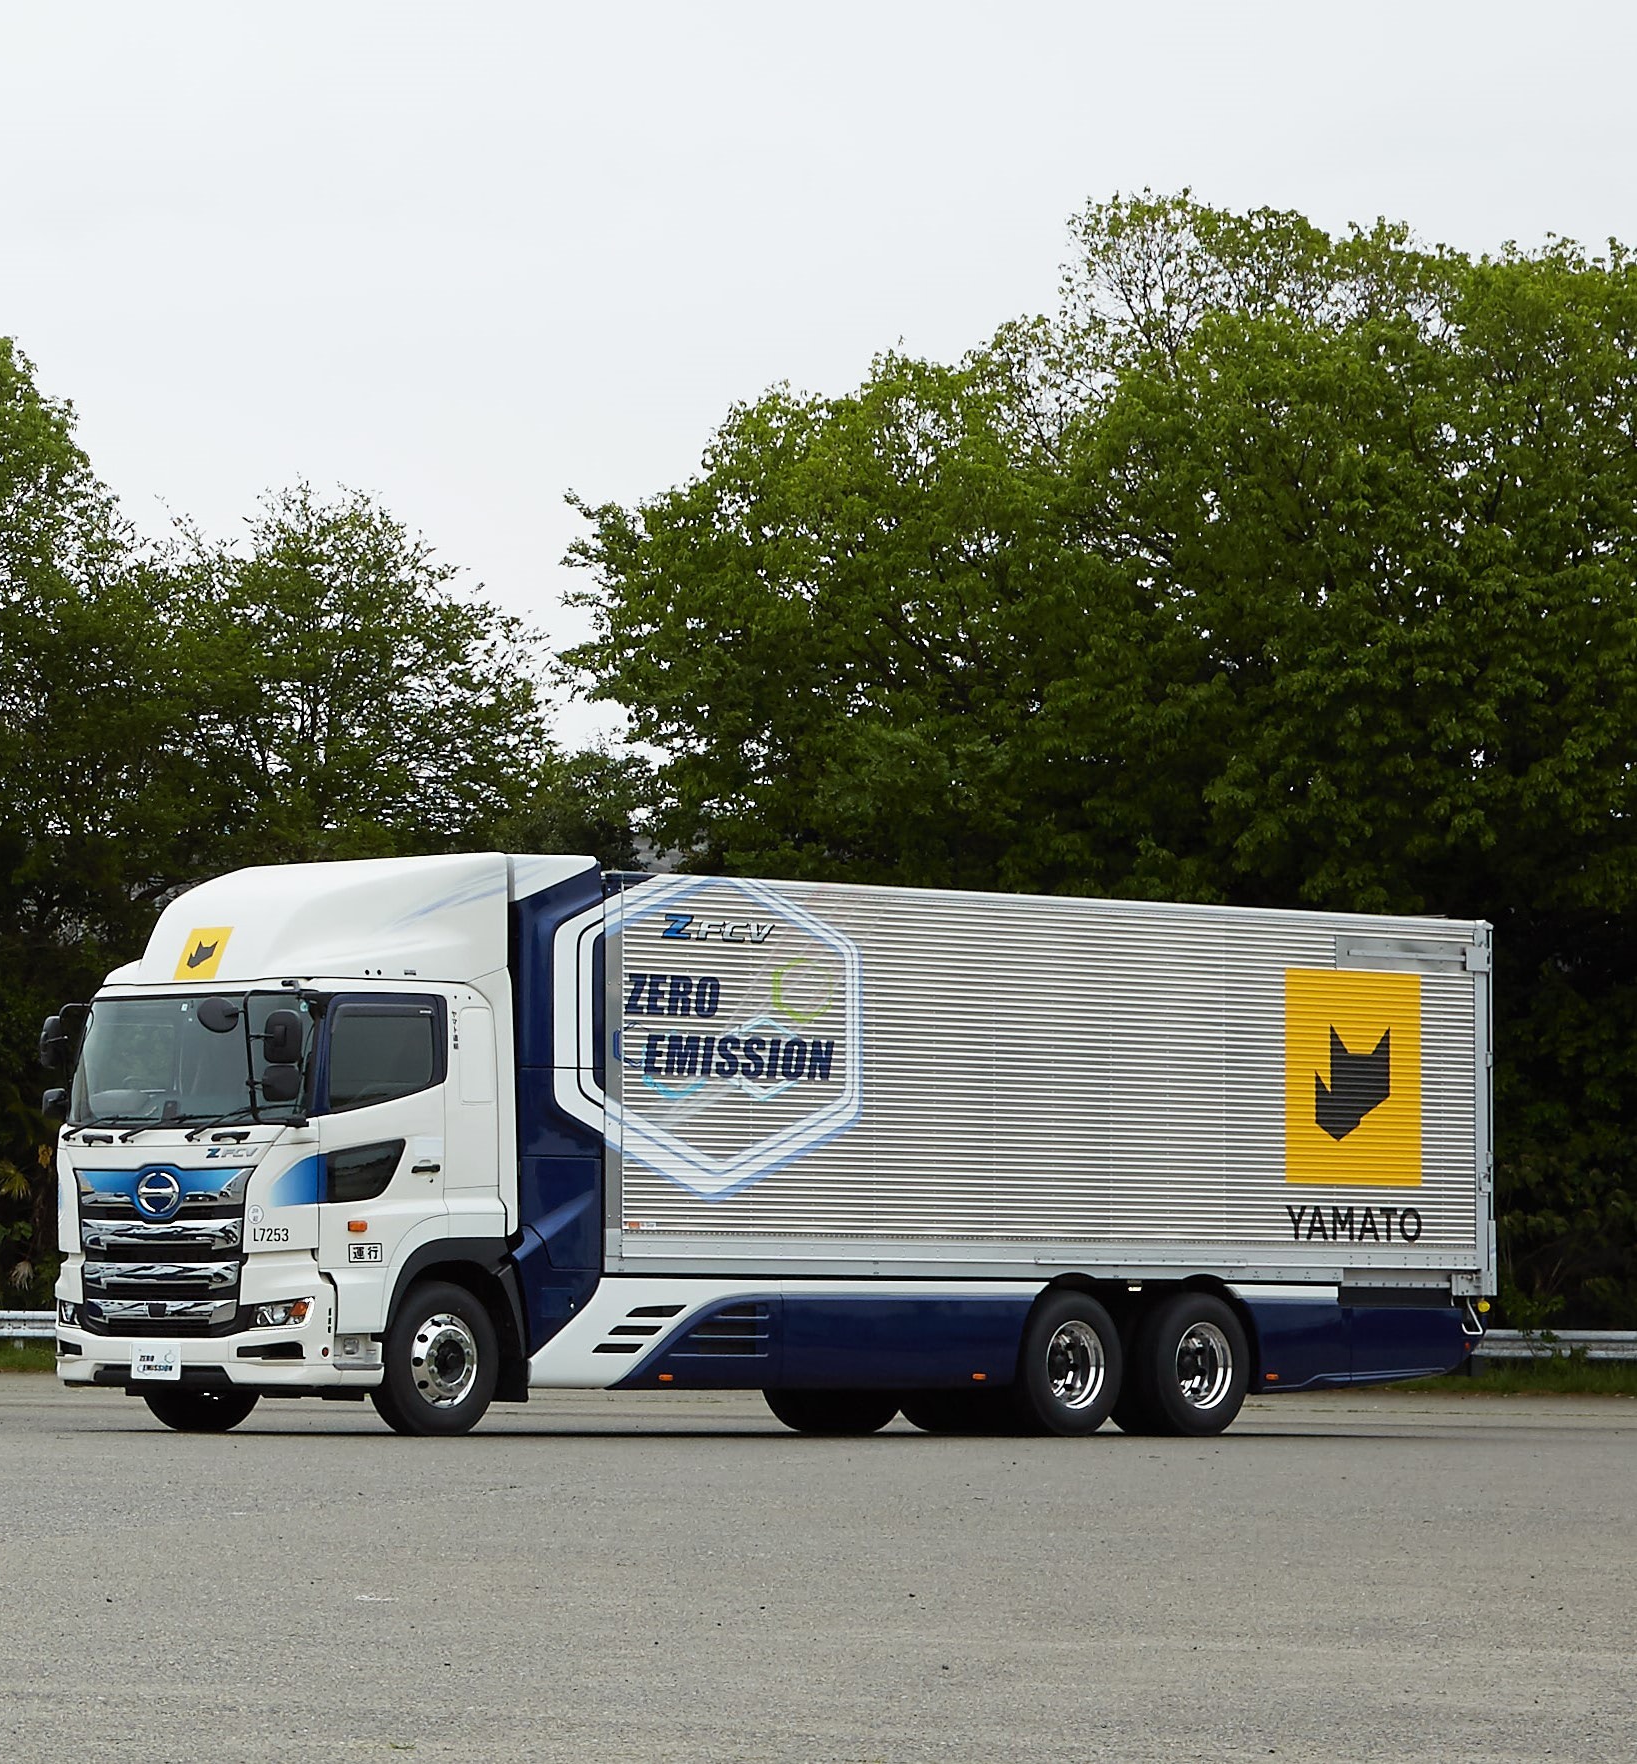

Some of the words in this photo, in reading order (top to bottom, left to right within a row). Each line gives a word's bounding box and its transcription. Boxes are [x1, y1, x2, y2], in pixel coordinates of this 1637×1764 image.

[625, 973, 721, 1018] ZERO
[644, 1034, 835, 1081] EMISSION
[253, 1227, 289, 1242] L7253
[1286, 1205, 1422, 1242] YAMATO
[352, 1246, 379, 1260] 運行
